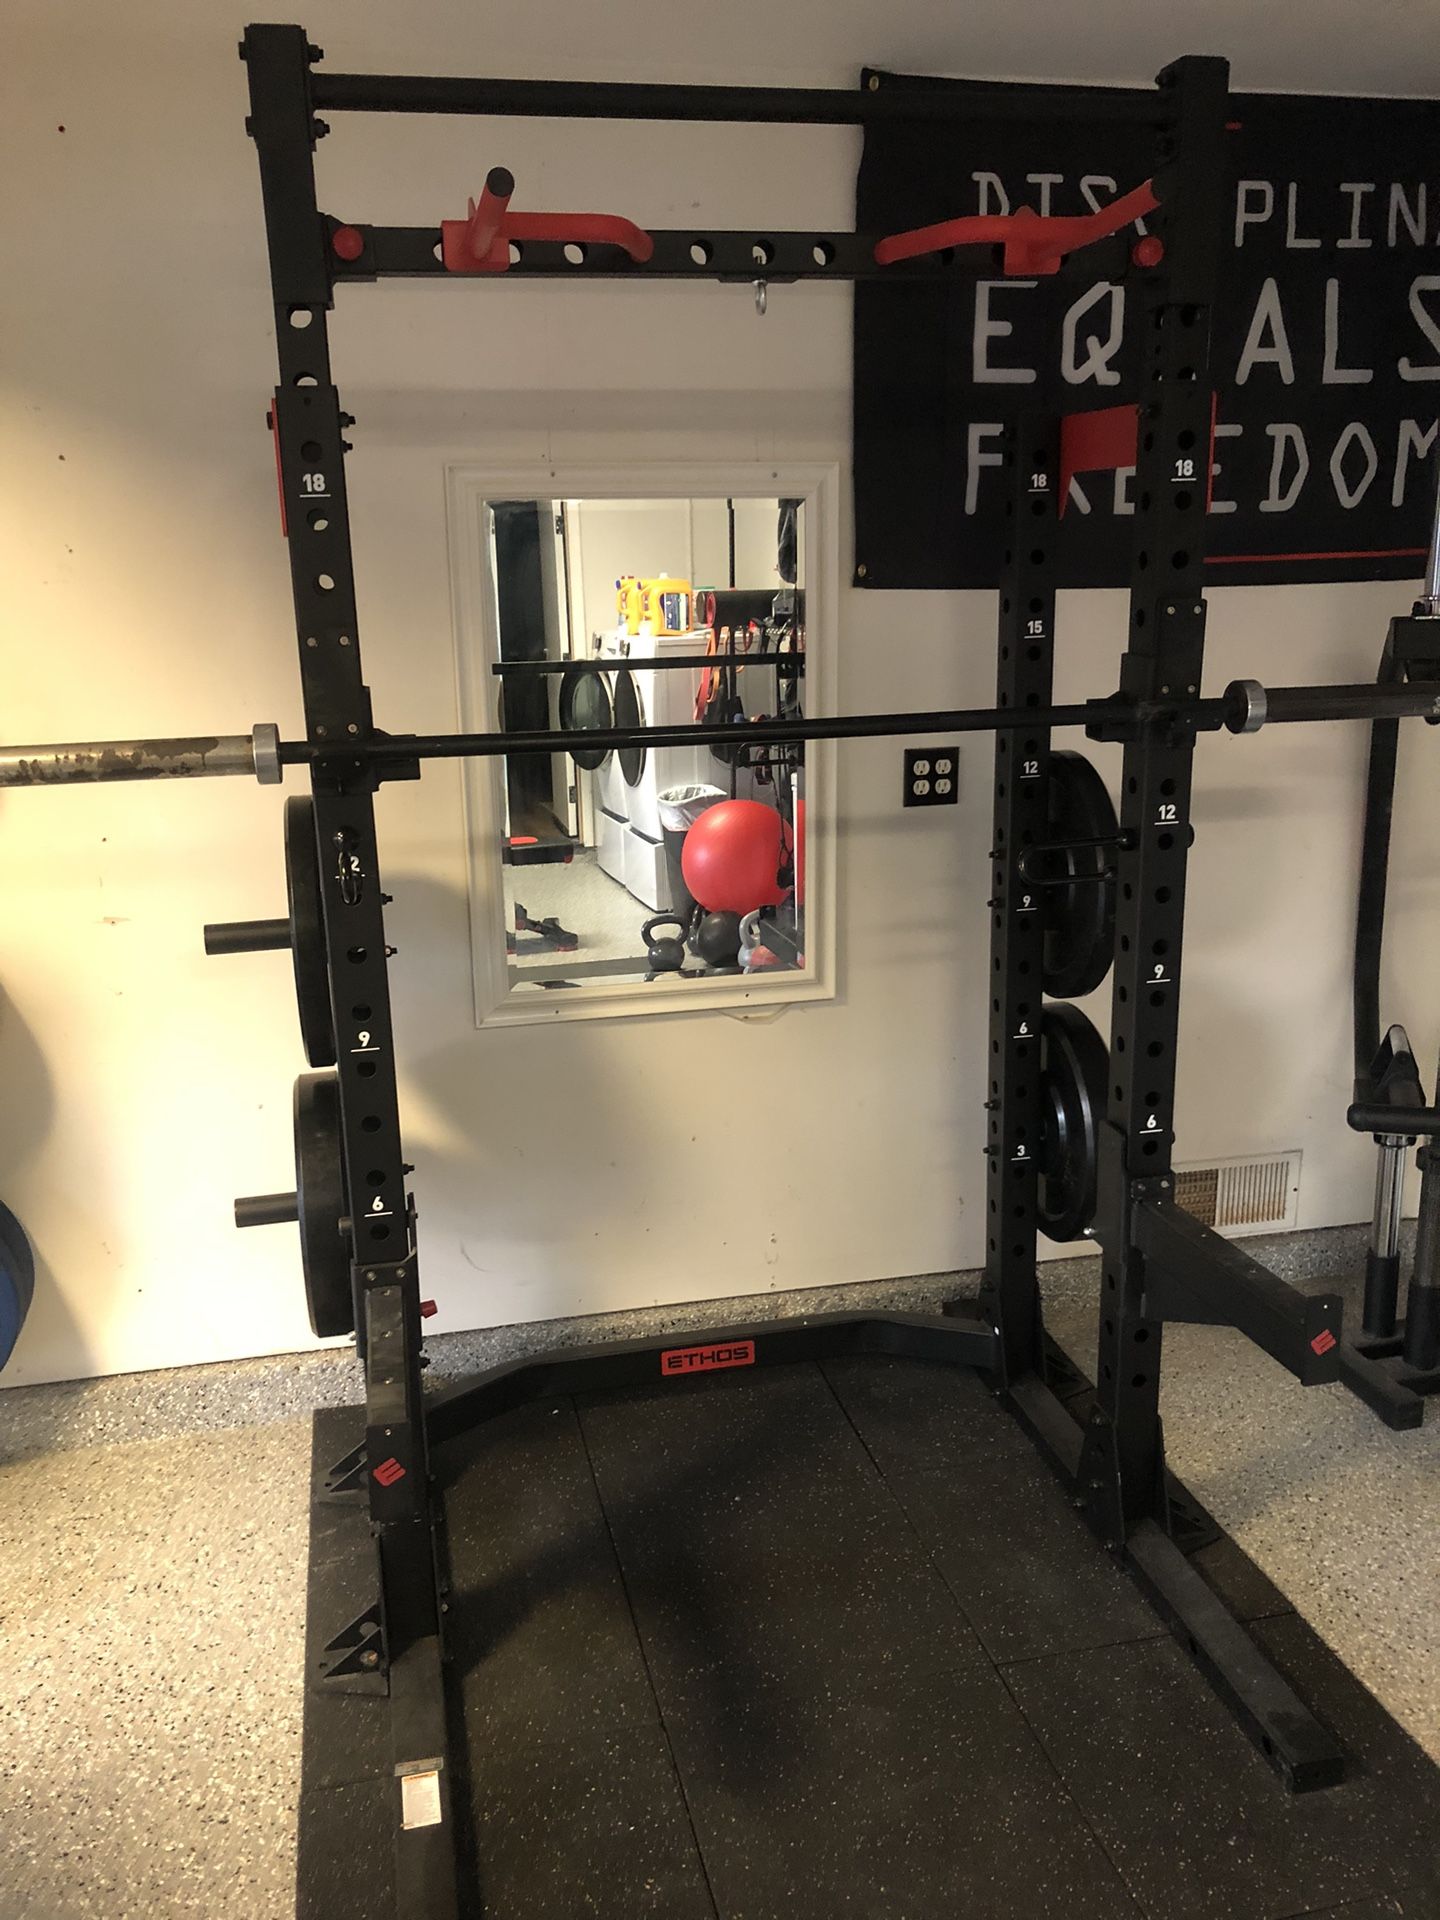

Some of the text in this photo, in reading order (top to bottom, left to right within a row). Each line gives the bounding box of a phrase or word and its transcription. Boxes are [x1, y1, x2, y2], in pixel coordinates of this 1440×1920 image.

[971, 171, 1440, 249] DISPLIN
[973, 276, 1440, 386] EQALS
[964, 418, 1438, 516] FEDOM
[1175, 459, 1193, 477] 18
[302, 473, 326, 492] 18
[1031, 473, 1047, 488] 18
[1027, 620, 1043, 634] 15
[1023, 761, 1038, 774] 12
[1158, 804, 1176, 820] 12
[1023, 895, 1031, 908] 9
[1154, 964, 1164, 979] 9
[1019, 1022, 1028, 1035] 6
[358, 1030, 371, 1048] 9
[1146, 1114, 1157, 1129] 6
[1017, 1144, 1025, 1157] 3
[372, 1195, 384, 1212] 6
[667, 1347, 749, 1369] ETHOS
